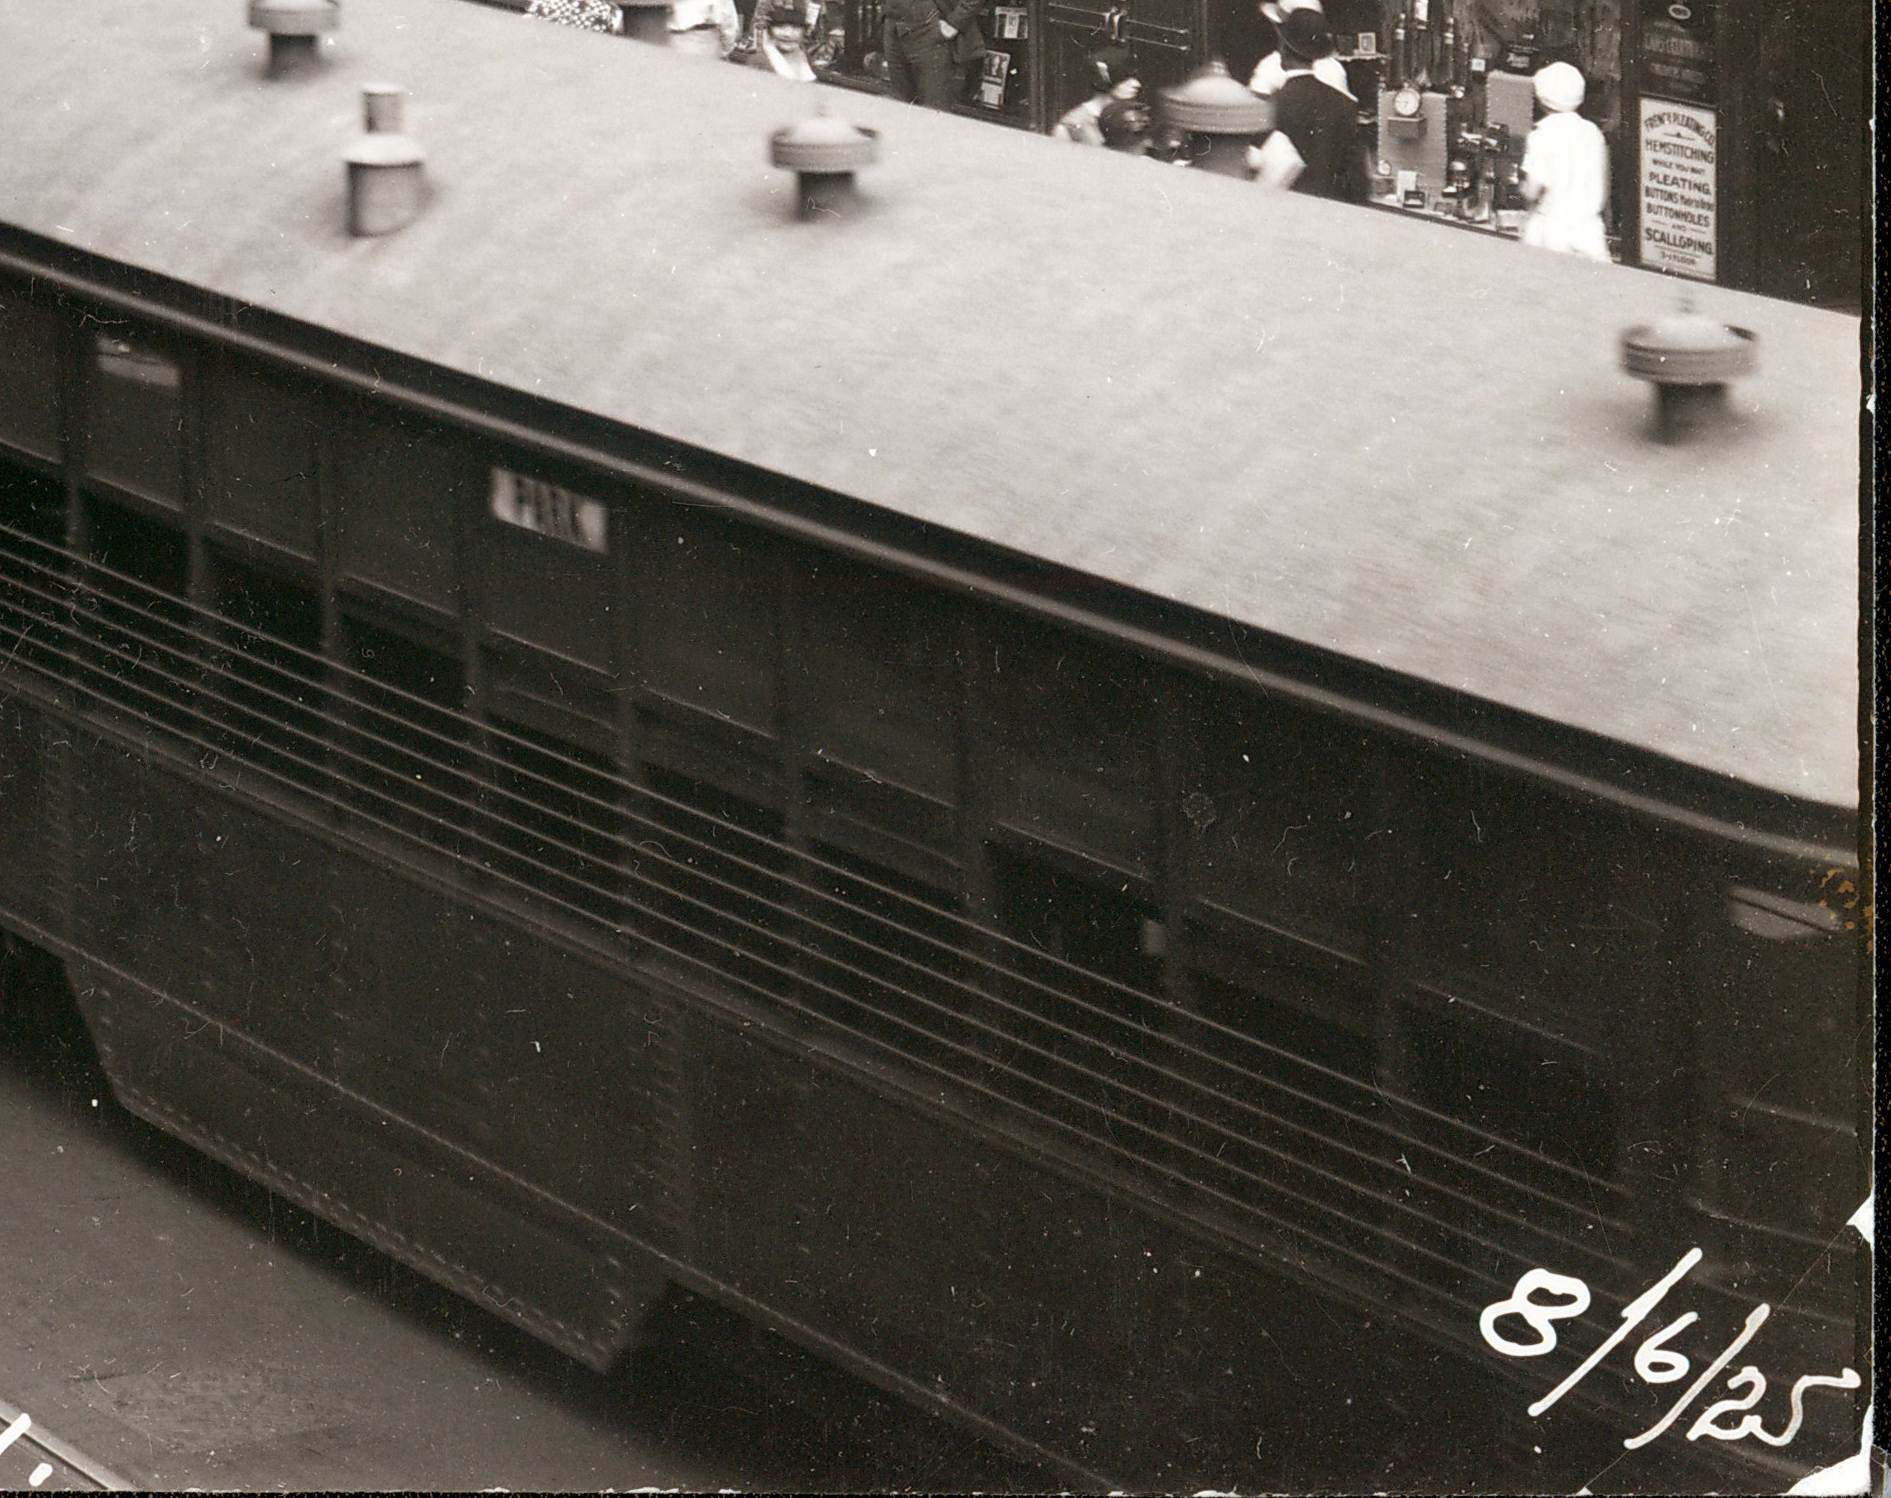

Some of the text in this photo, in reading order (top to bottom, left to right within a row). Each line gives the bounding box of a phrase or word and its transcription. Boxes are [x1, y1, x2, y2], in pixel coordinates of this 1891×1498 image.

[1644, 111, 1672, 132] FRENCH
[1672, 111, 1705, 138] PLEATING
[1645, 138, 1715, 165] HEMSTITCHING
[1645, 185, 1680, 205] BUTTONS
[1646, 202, 1711, 228] BUTTONHOLES
